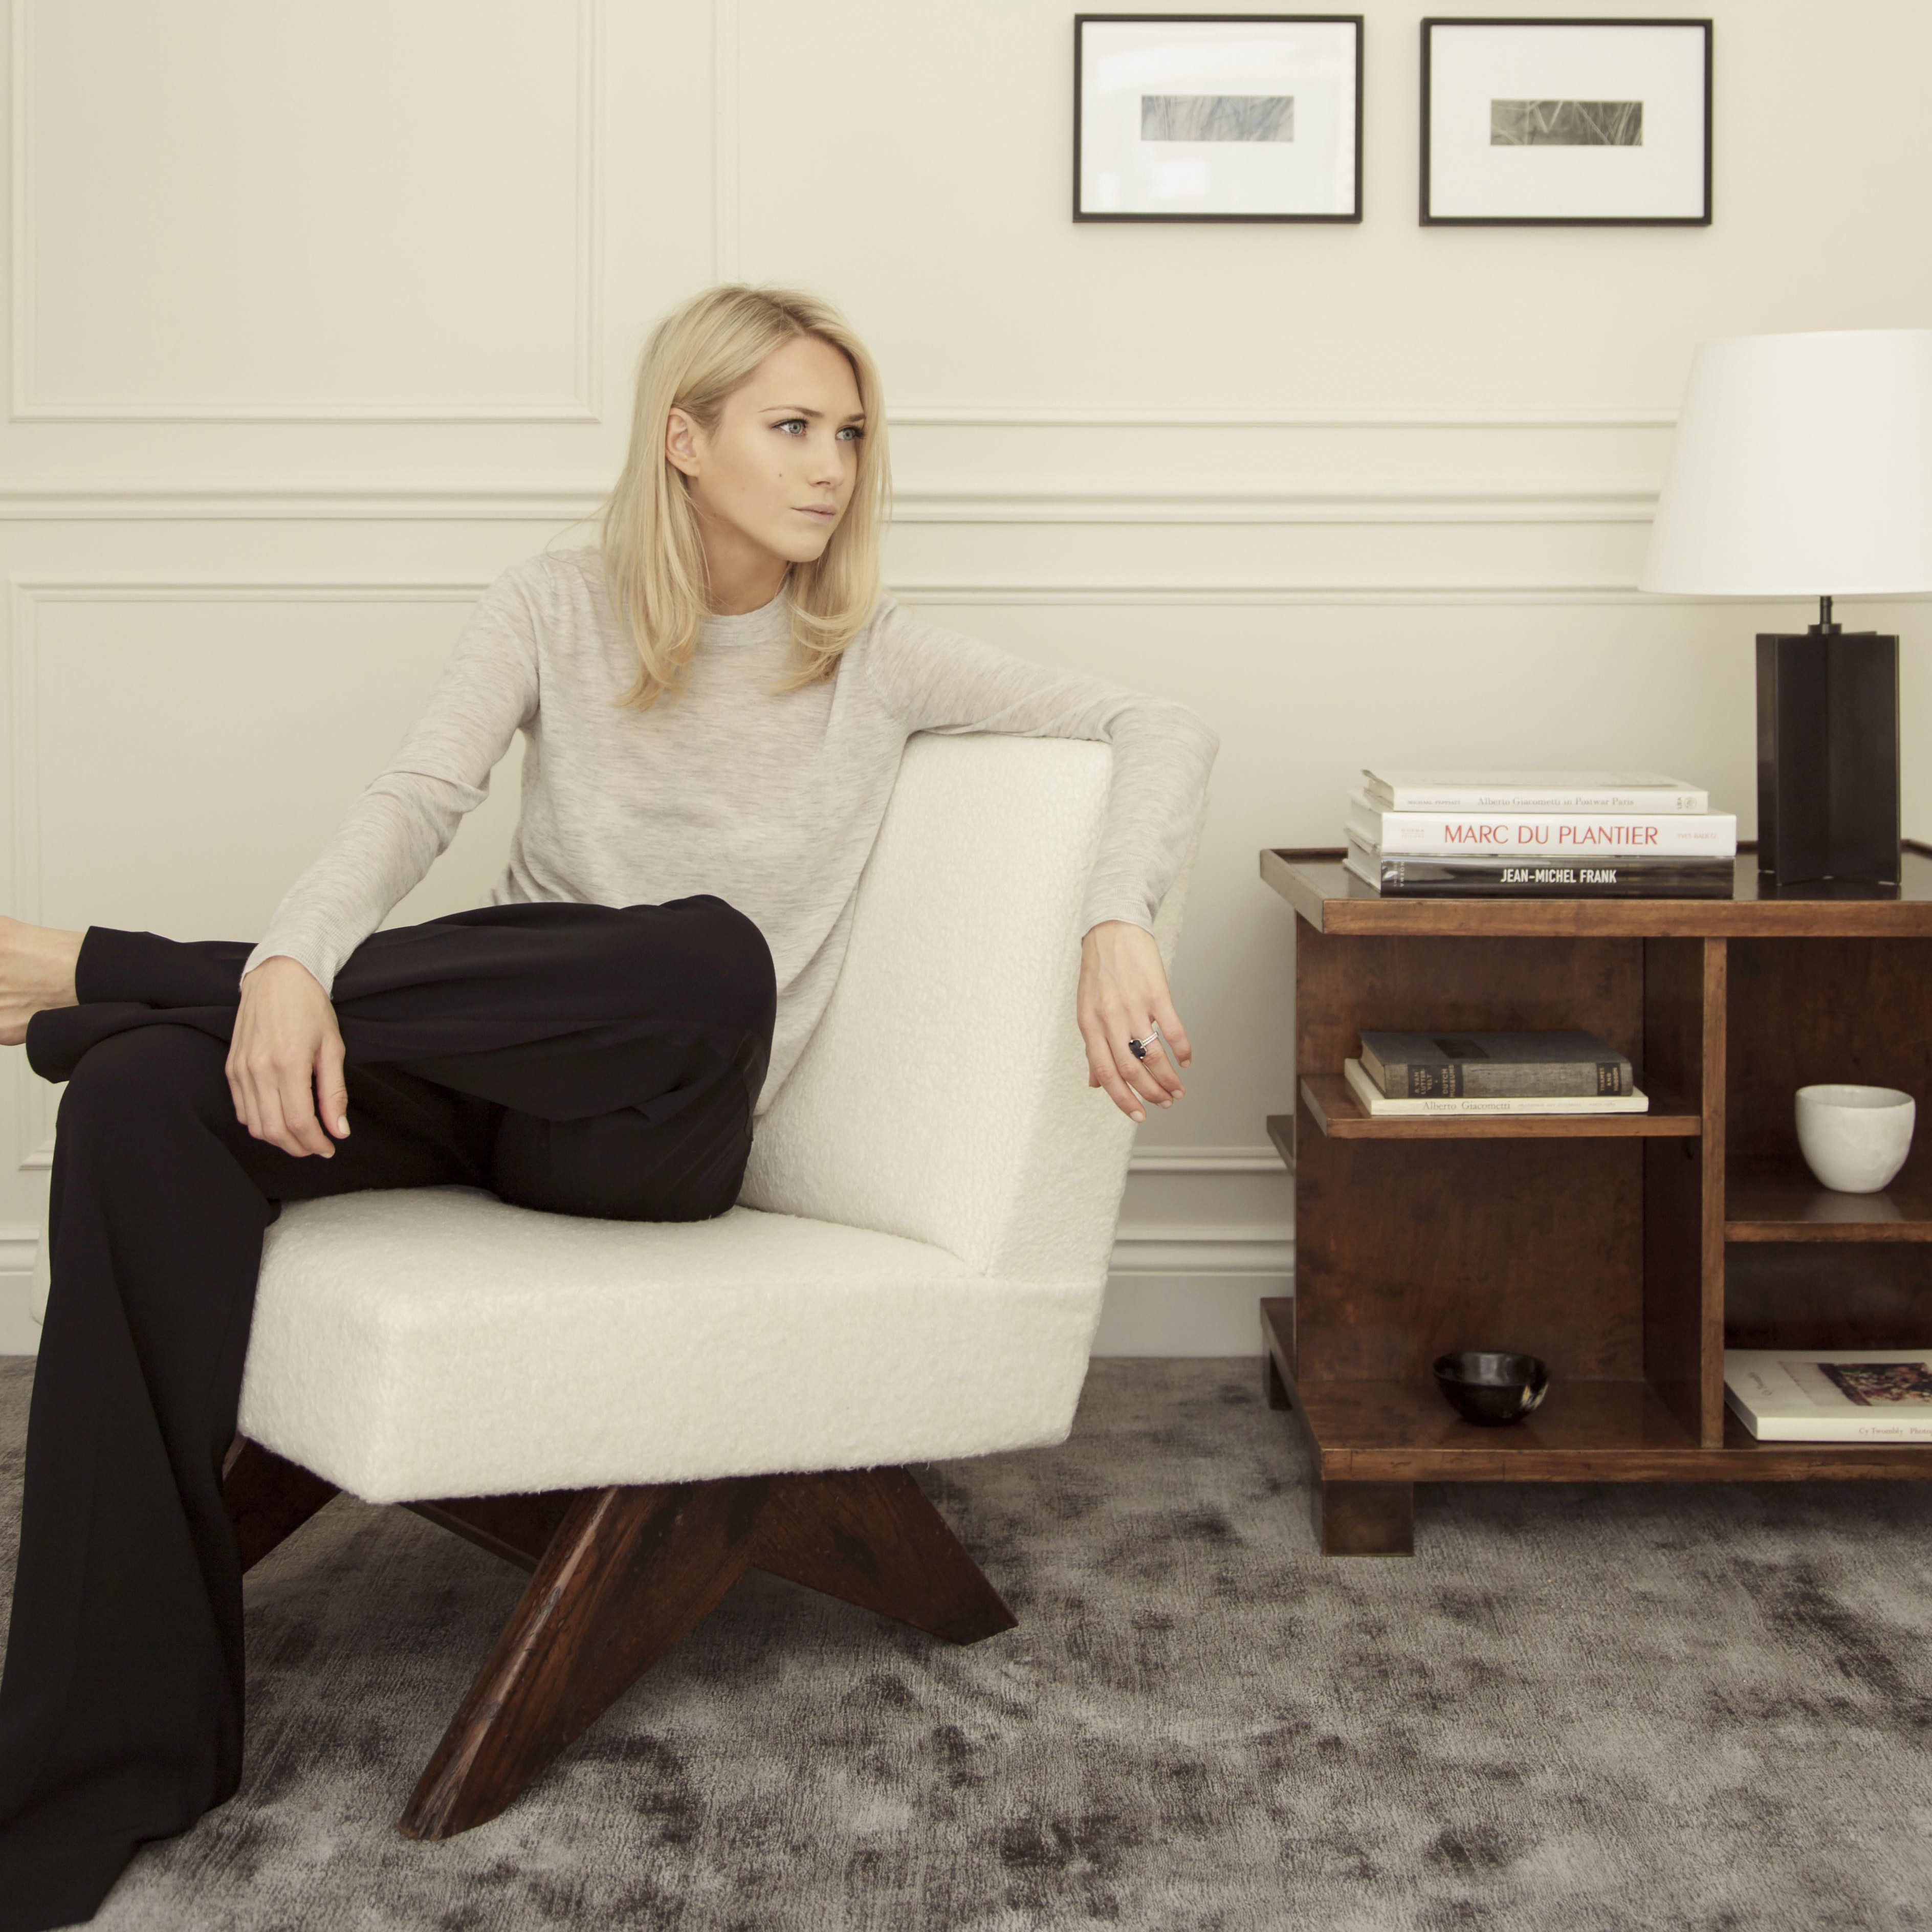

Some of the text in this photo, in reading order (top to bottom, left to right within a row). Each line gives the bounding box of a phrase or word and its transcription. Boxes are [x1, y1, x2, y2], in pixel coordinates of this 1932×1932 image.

[1477, 797, 1634, 807] Alberto Giacometti in Postwar Paris
[1444, 825, 1658, 845] MARC DU PLANTIER
[1500, 868, 1617, 884] JEAN-MICHEL FRANK
[1422, 1101, 1457, 1110] Alberto
[1461, 1100, 1510, 1110] Giacometti
[1858, 1426, 1869, 1437] Cy
[1871, 1426, 1903, 1437] Twombly
